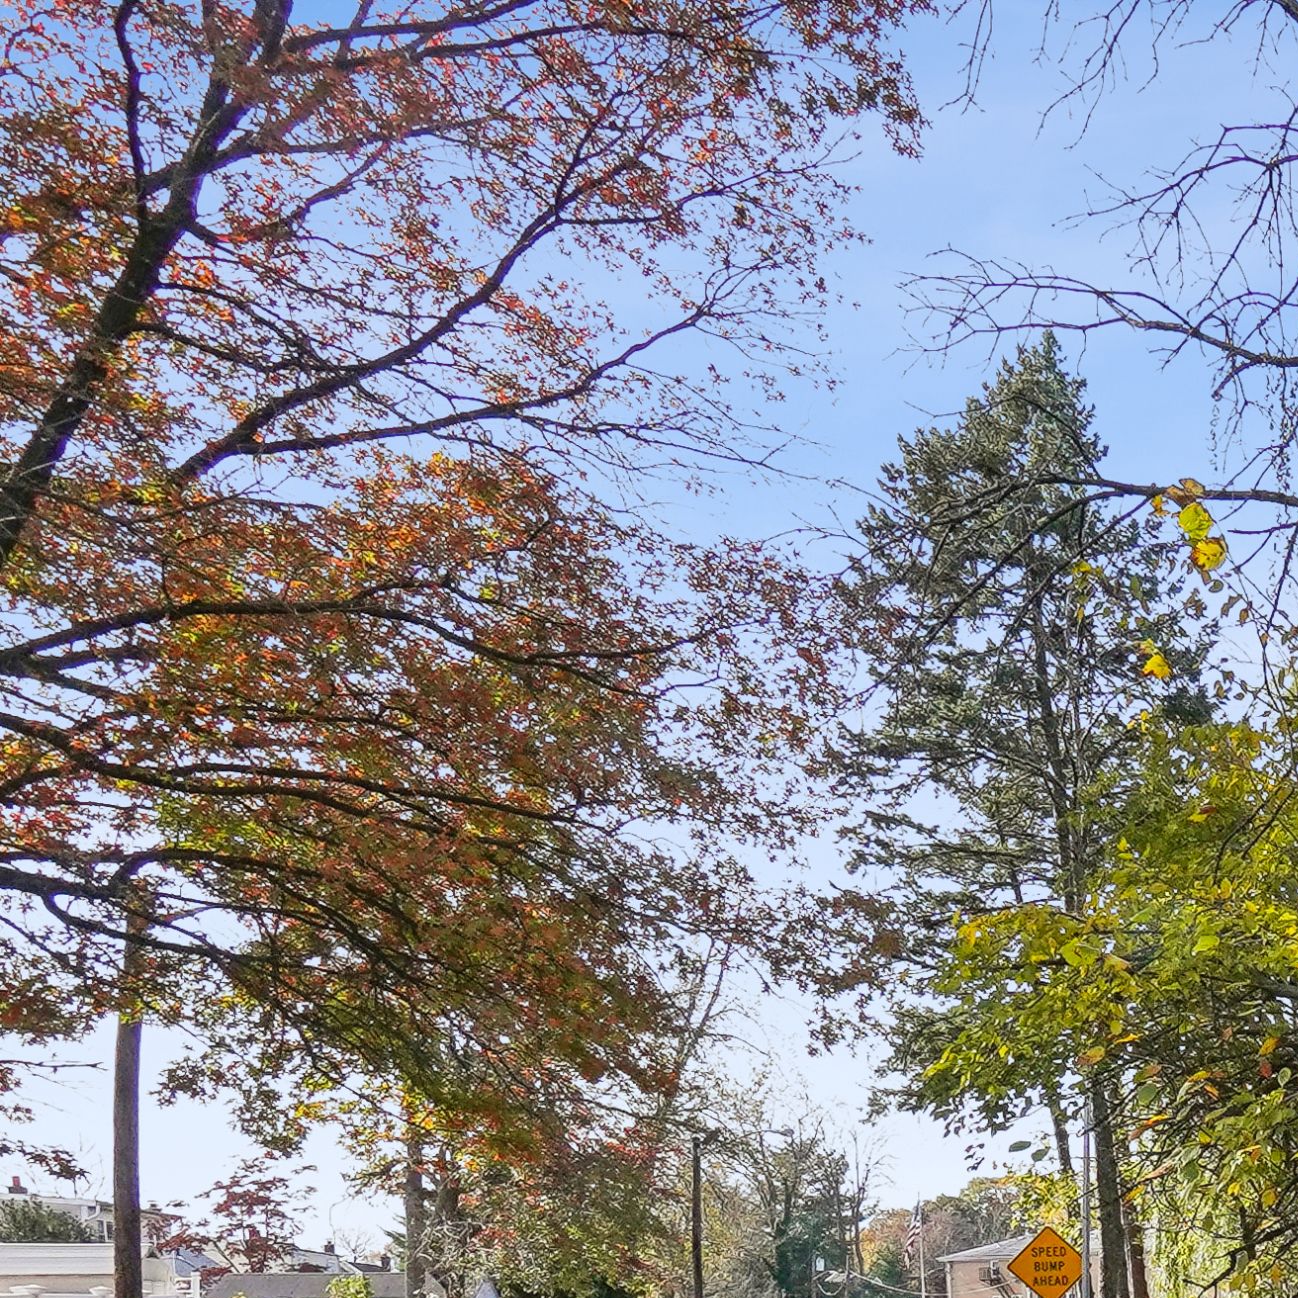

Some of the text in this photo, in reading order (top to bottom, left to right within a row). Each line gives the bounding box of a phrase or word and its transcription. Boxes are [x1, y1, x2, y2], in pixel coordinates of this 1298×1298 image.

[1031, 1246, 1067, 1257] SPEED
[1034, 1261, 1065, 1272] BUMP
[1032, 1275, 1069, 1286] AHEAD
